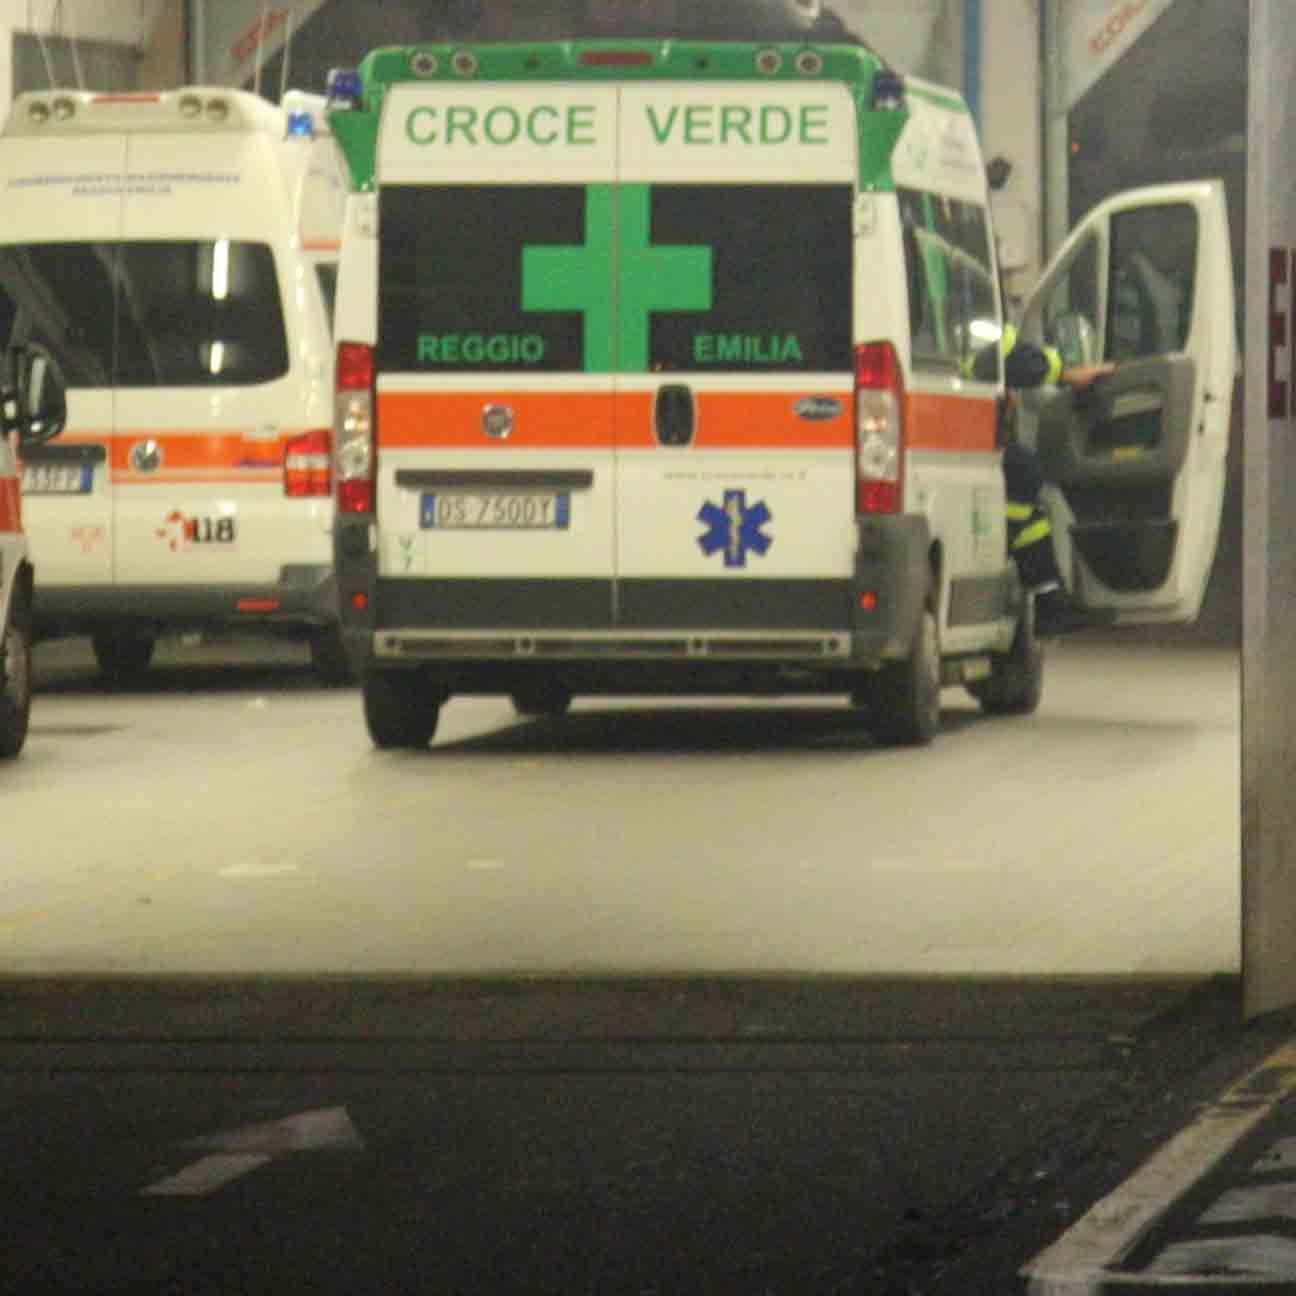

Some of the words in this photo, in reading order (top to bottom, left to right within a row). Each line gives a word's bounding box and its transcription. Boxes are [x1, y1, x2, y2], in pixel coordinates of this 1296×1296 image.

[405, 105, 596, 145] CROCE
[646, 104, 829, 145] VERDE
[416, 333, 545, 363] REGGIO
[692, 333, 803, 363] EMILIA
[191, 516, 235, 544] 118
